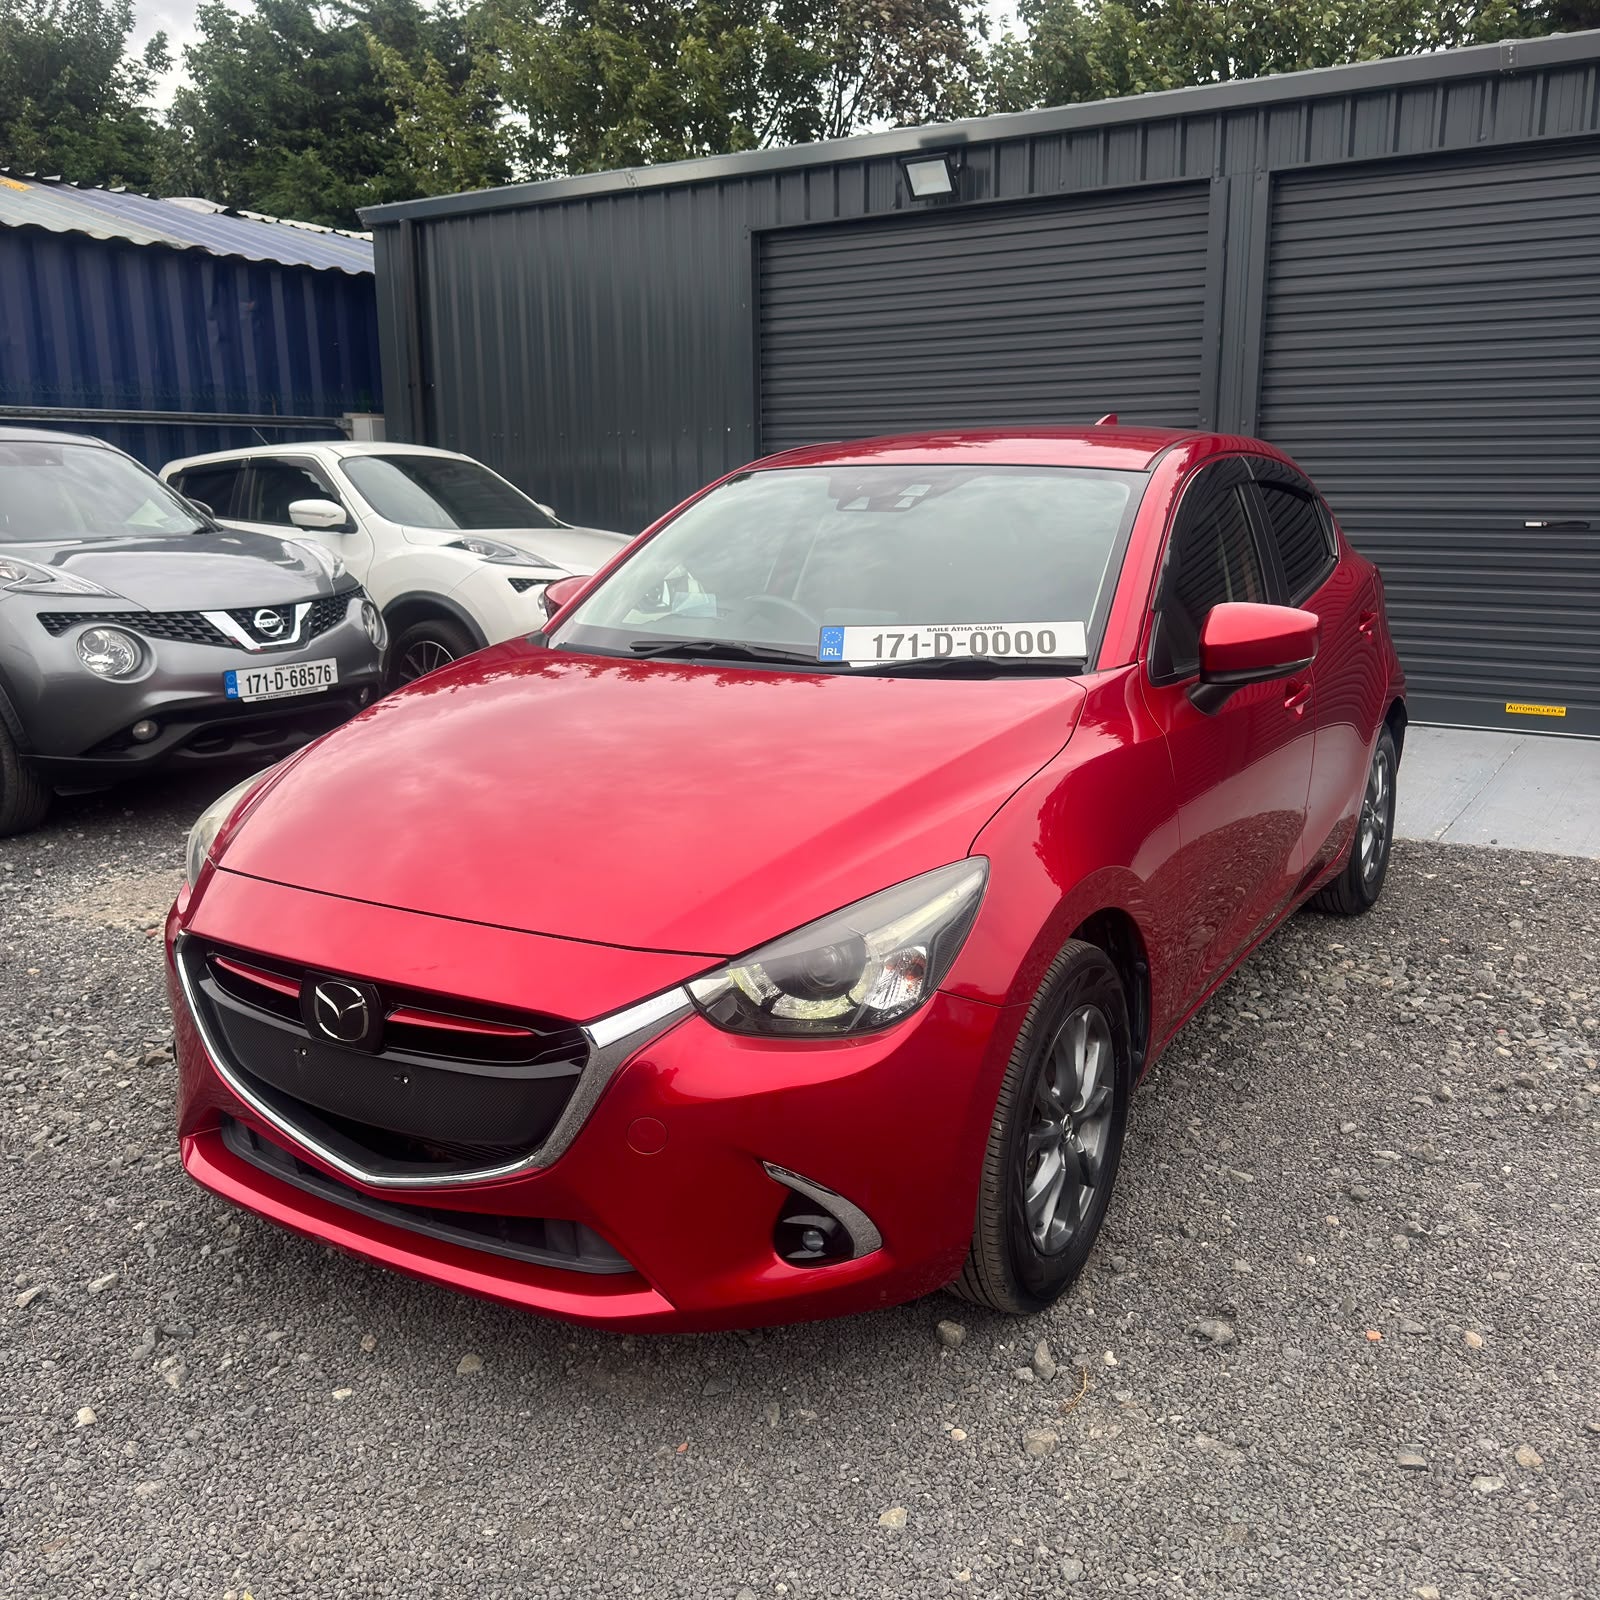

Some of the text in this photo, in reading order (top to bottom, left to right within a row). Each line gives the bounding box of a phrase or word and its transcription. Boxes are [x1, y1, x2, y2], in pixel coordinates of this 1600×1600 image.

[823, 647, 841, 656] IRL
[872, 630, 1057, 658] 171-D-0000
[246, 665, 331, 694] 171-D-68576
